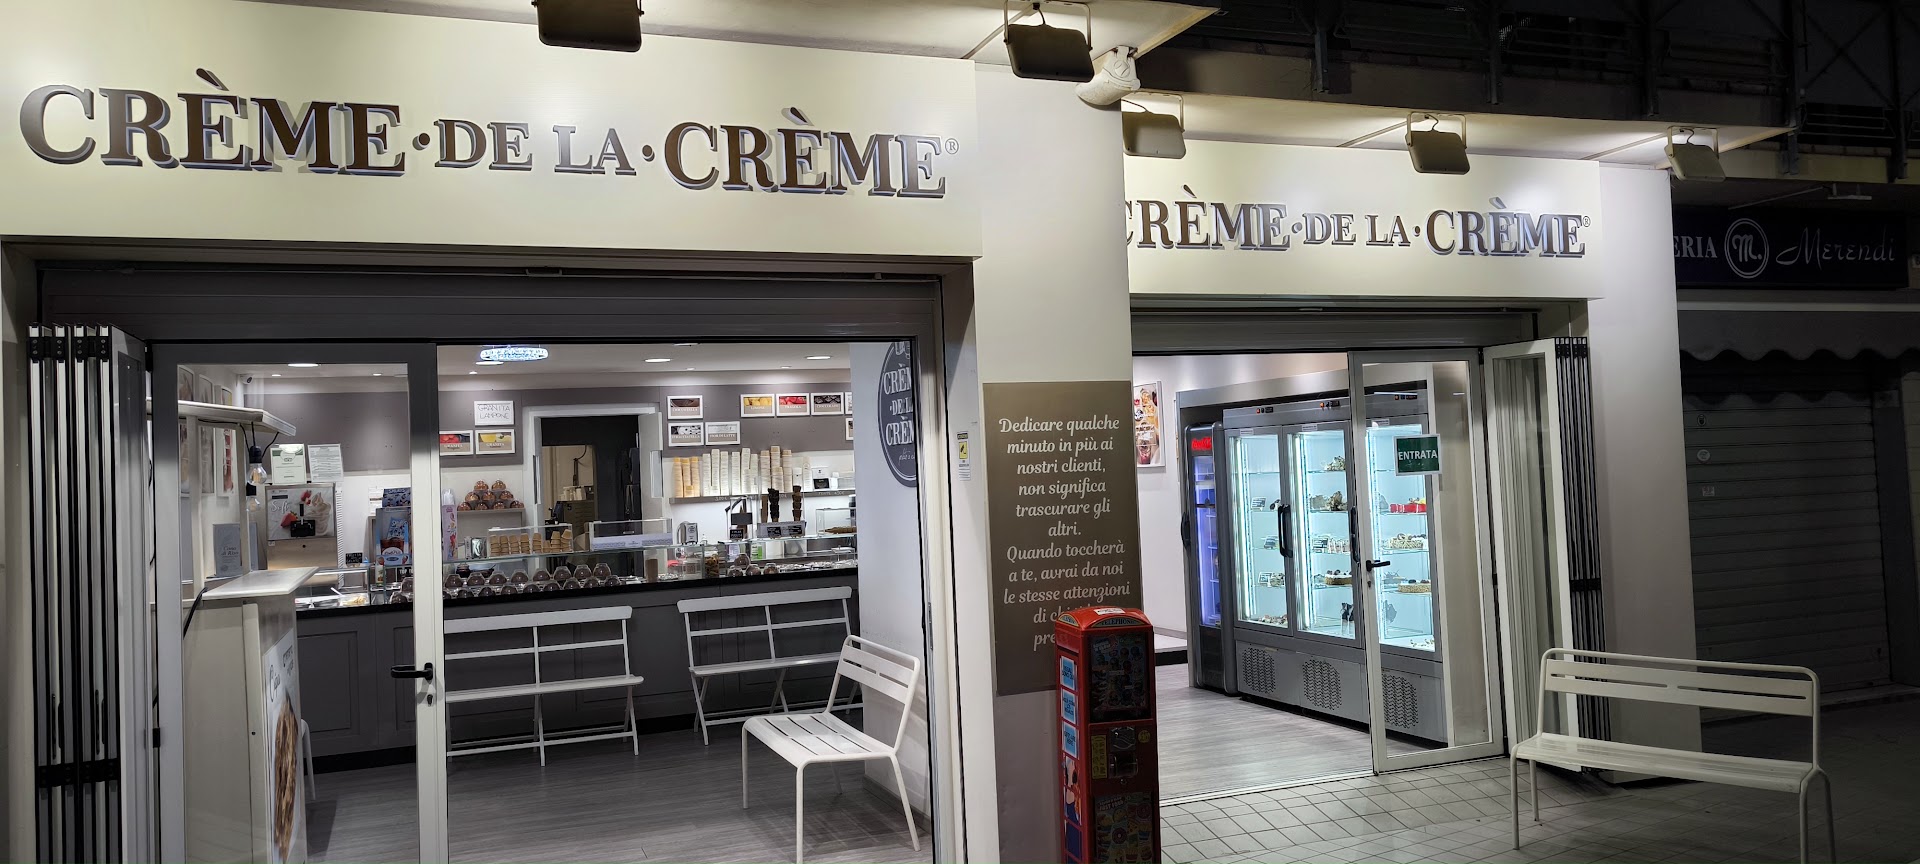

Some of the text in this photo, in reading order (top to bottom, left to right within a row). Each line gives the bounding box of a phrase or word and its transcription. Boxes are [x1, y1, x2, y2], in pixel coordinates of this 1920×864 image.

[20, 67, 406, 177] CRÈME
[434, 118, 533, 172] DE
[553, 124, 637, 176] LA
[1303, 212, 1355, 246] DE
[1365, 213, 1411, 247] LA
[1776, 224, 1896, 271] Merendi
[905, 396, 913, 413] L
[999, 416, 1064, 433] Dedicare
[1066, 414, 1120, 437] qualche
[1007, 436, 1114, 457] minuto in più ai
[1398, 449, 1438, 461] ENTRATA
[1017, 457, 1106, 475] nostri clienti,
[1018, 477, 1106, 500] non significa
[1016, 497, 1111, 519] trascurare gli
[1048, 520, 1082, 537] altri.
[1006, 540, 1126, 563] Quando toccherà
[1008, 561, 1124, 582] a te, avrai da noi
[1003, 581, 1131, 604] le stesse attenzioni
[1033, 608, 1047, 624] di
